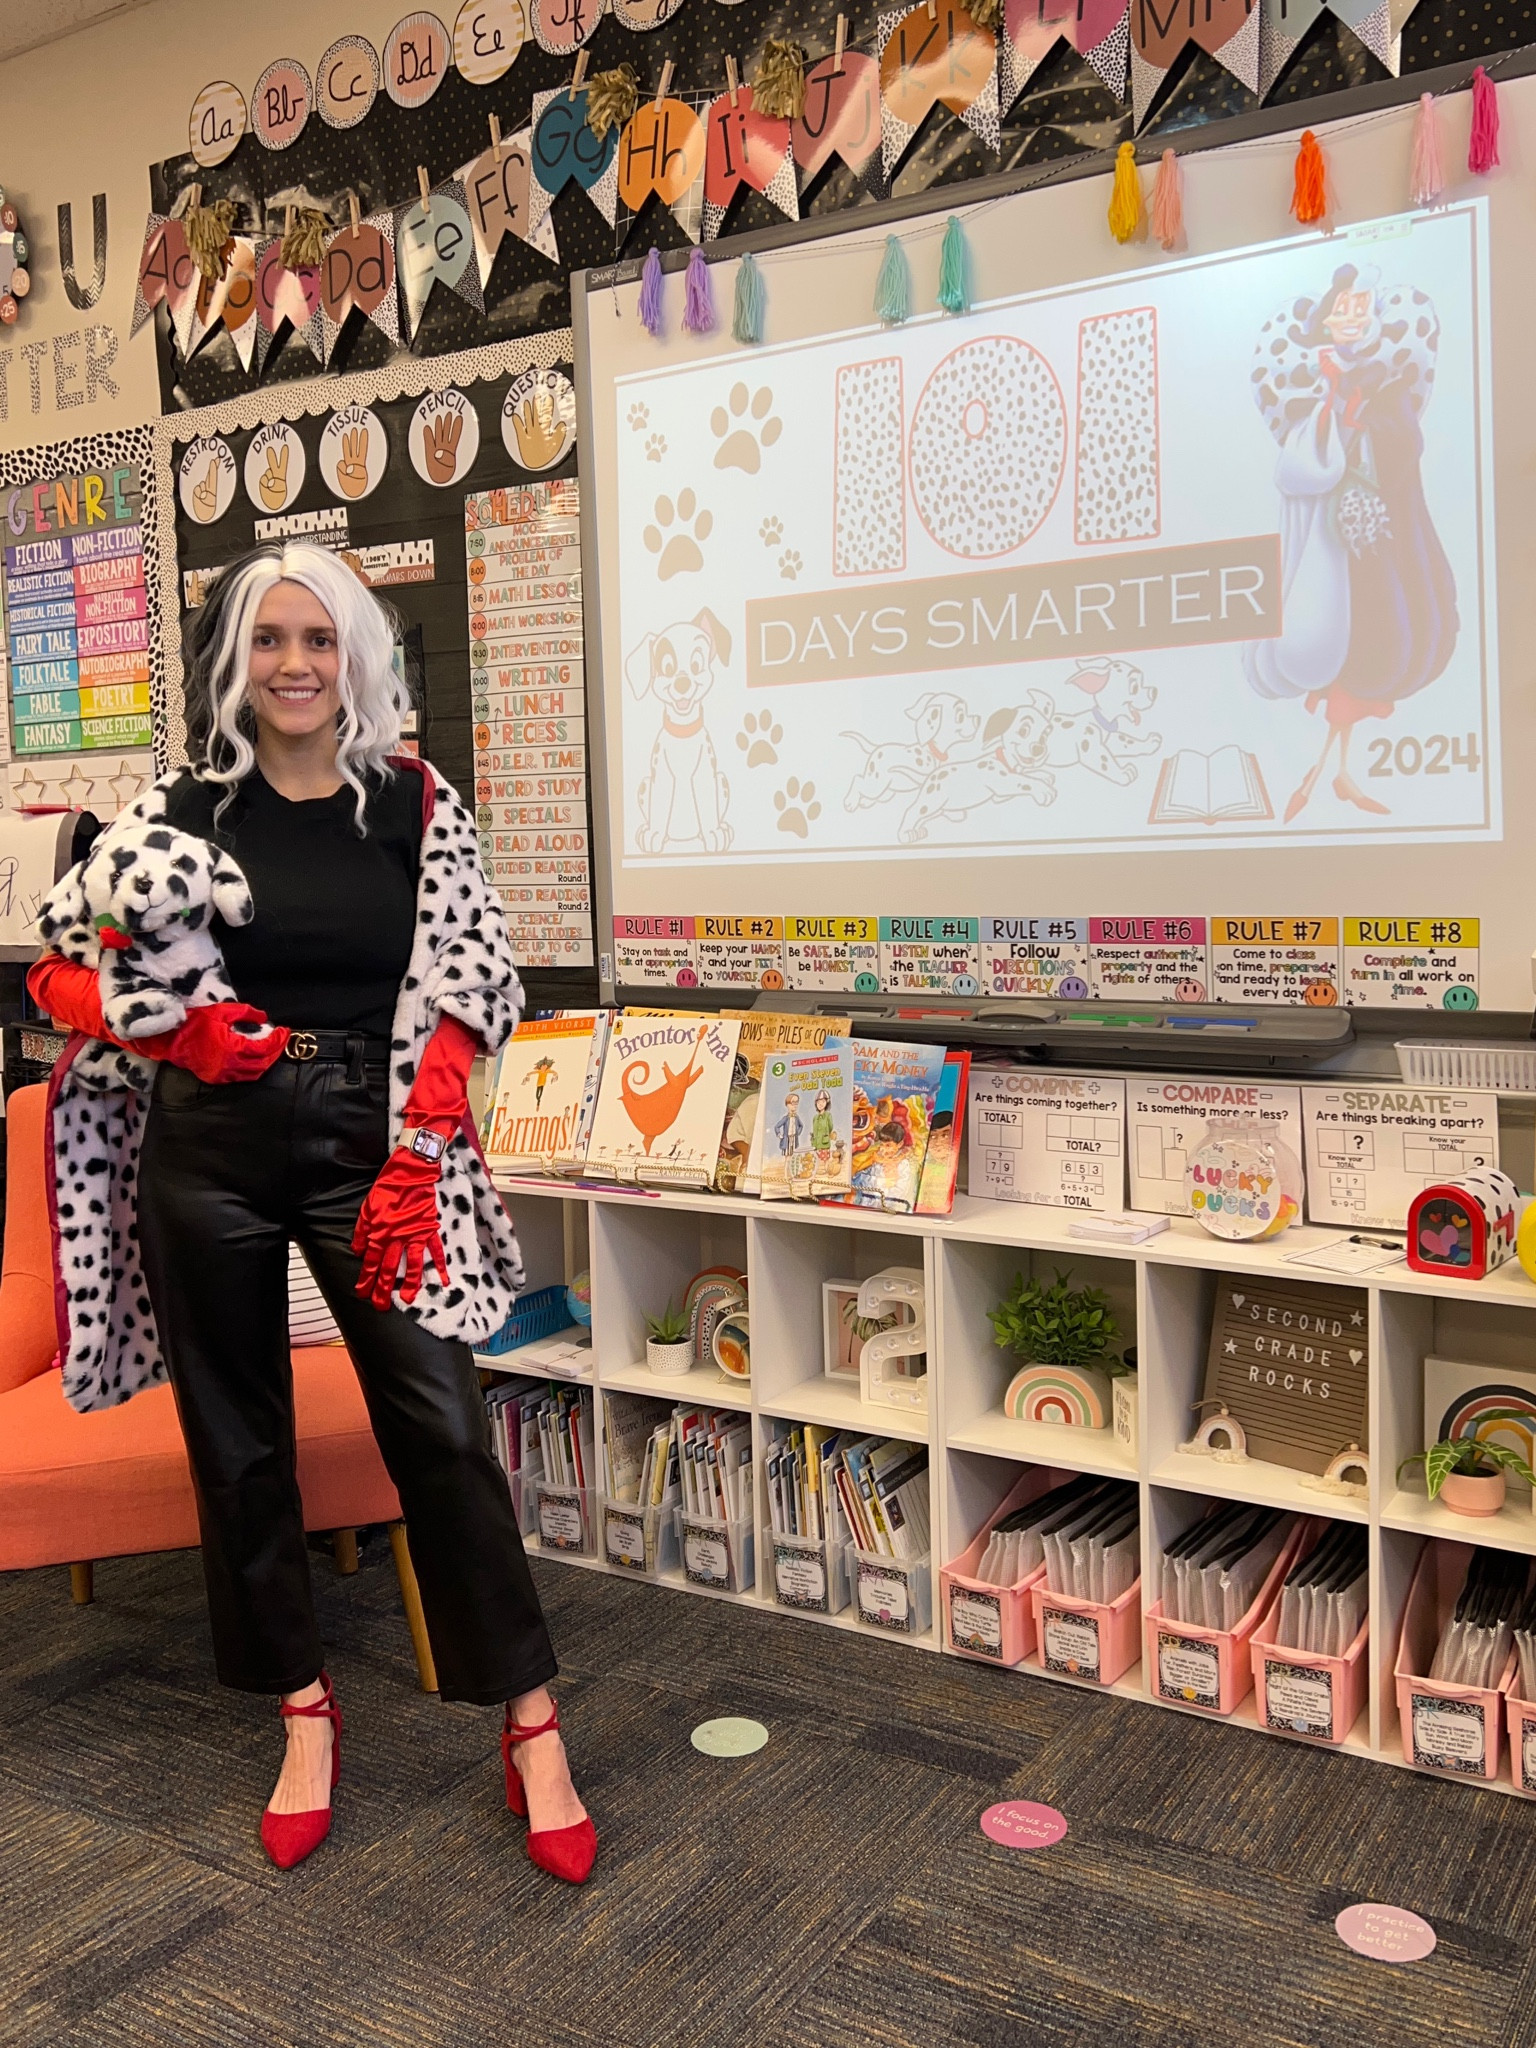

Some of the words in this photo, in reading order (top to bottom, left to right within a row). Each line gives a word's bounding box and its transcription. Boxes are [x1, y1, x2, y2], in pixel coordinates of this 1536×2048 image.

[397, 35, 436, 85] Dd
[329, 62, 367, 101] Cc
[264, 86, 304, 128] Bb
[802, 71, 872, 149] Jj
[201, 108, 234, 146] Aa
[535, 105, 608, 174] Gg
[626, 111, 687, 185] Hh
[717, 113, 750, 178] Ii
[475, 153, 525, 233] Ff
[407, 218, 464, 281] Ee
[328, 236, 386, 304] Dd
[591, 268, 615, 284] SMART
[418, 391, 465, 421] PENCIL
[327, 407, 370, 437] TISSUE
[252, 426, 289, 455] DRINK
[833, 306, 1161, 577] 101
[181, 436, 235, 476] RESTROOM
[7, 468, 132, 536] GENRE
[72, 526, 142, 557] NON-FICTION
[489, 534, 576, 553] ANNOUNCEMENTS
[15, 538, 62, 566] FICTION
[500, 550, 546, 567] PROBLEM
[549, 548, 563, 560] OF
[80, 556, 137, 585] BIOGRAPHY
[512, 566, 528, 578] THE
[532, 564, 550, 576] DAY
[8, 577, 43, 594] REALISTIC
[44, 570, 74, 587] FICTION
[489, 587, 524, 604] MATH
[527, 580, 578, 600] LESSON
[47, 602, 75, 618] FICTION
[85, 598, 136, 618] NON-FICTION
[760, 606, 908, 667] DAYS
[927, 564, 1265, 651] SMARTER
[488, 616, 515, 631] MATH
[16, 634, 42, 656] FAIRY
[46, 630, 71, 652] TALE
[77, 622, 147, 649] EXPOSITORY
[490, 640, 579, 660] INTERVENTION
[19, 660, 70, 686] FOLKTALE
[79, 652, 149, 676] AUTOBIOGRAPHY
[498, 665, 570, 687] WRITING
[30, 692, 62, 715] FABLE
[92, 685, 134, 708] POETRY
[504, 692, 564, 717] LUNCH
[114, 715, 151, 731] FICTION
[503, 721, 567, 745] RECESS
[24, 723, 71, 747] FANTASY
[542, 750, 582, 768] TIME
[1368, 732, 1480, 777] 2024
[494, 780, 533, 797] WORD
[537, 778, 582, 797] STUDY
[504, 806, 572, 824] SPECIALS
[496, 836, 530, 852] READ
[535, 834, 584, 852] ALOUD
[496, 861, 532, 874] GUIDED
[535, 860, 586, 874] READING
[558, 874, 582, 882] Round
[536, 889, 588, 902] READING
[558, 902, 582, 910] Round
[541, 927, 582, 939] STUDIES
[625, 918, 663, 936] RULE
[705, 918, 743, 937] RULE
[750, 919, 774, 937] #2
[796, 919, 836, 938] RULE
[843, 920, 867, 938] #3
[891, 919, 933, 939] RULE
[942, 920, 969, 939] #4
[993, 920, 1039, 939] RULE
[1048, 920, 1077, 940] #5
[1102, 920, 1155, 940] RULE
[1164, 921, 1192, 940] #6
[1226, 921, 1283, 941] RULE
[1293, 921, 1322, 940] #7
[1359, 921, 1421, 942] RULE
[1430, 922, 1462, 943] #8
[564, 941, 581, 953] GO
[622, 947, 640, 958] Stay
[673, 948, 688, 957] and
[726, 944, 748, 955] your
[751, 944, 781, 954] HANDS
[892, 945, 929, 958] LISTEN
[933, 945, 969, 958] when
[1010, 943, 1060, 958] Follow
[1097, 948, 1140, 960] Respect
[1233, 948, 1265, 960] Come
[1269, 948, 1282, 959] to
[1285, 949, 1316, 960] class
[527, 955, 557, 966] HOME
[708, 957, 727, 967] and
[730, 958, 752, 969] your
[813, 960, 858, 973] HONEST.
[918, 960, 968, 974] TEACHER
[993, 959, 1076, 975] DIRECTIONS
[1101, 962, 1152, 974] property
[1156, 961, 1177, 972] and
[1179, 961, 1198, 972] the
[1364, 954, 1427, 969] Complete
[1431, 956, 1456, 967] and
[903, 975, 951, 989] TALKING.
[993, 976, 1054, 994] QUICKLY
[1102, 973, 1135, 985] rights
[1154, 974, 1193, 985] others.
[1243, 974, 1286, 987] ready
[1351, 969, 1380, 980] turn
[1399, 970, 1413, 981] all
[1418, 970, 1453, 982] work
[1458, 973, 1475, 982] on
[1243, 989, 1279, 999] every
[777, 1025, 803, 1044] PILES
[797, 1055, 838, 1067] SCHOLASTIC
[880, 1050, 901, 1059] AND
[902, 1051, 919, 1061] THE
[811, 1069, 841, 1081] Steven
[881, 1060, 929, 1078] MONEY
[1005, 1076, 1086, 1098] COMBINE
[1163, 1084, 1258, 1106] COMPARE
[975, 1093, 993, 1103] Are
[996, 1093, 1023, 1107] things
[1026, 1098, 1062, 1110] coming
[1065, 1098, 1117, 1112] together?
[1151, 1105, 1206, 1118] something
[1260, 1110, 1289, 1120] less?
[1343, 1092, 1451, 1114] SEPARATE
[985, 1112, 1017, 1124] TOTAL?
[1316, 1111, 1338, 1121] Are
[1342, 1112, 1378, 1124] things
[1381, 1112, 1437, 1127] breaking
[1440, 1117, 1484, 1129] apart?
[489, 1103, 578, 1160] Earrings!
[1066, 1140, 1101, 1153] TOTAL?
[1193, 1164, 1273, 1195] LUCKY
[1064, 1195, 1092, 1207] TOTAL
[1191, 1189, 1270, 1220] DUCKS
[1250, 1305, 1342, 1337] SECOND
[1255, 1337, 1332, 1367] GRADE
[1249, 1366, 1330, 1398] ROCKS
[992, 1816, 1012, 1828] the
[1015, 1825, 1049, 1839] good.
[1007, 1810, 1040, 1825] focus
[1044, 1822, 1059, 1830] on
[1366, 1913, 1425, 1933] practice
[1384, 1930, 1409, 1941] get
